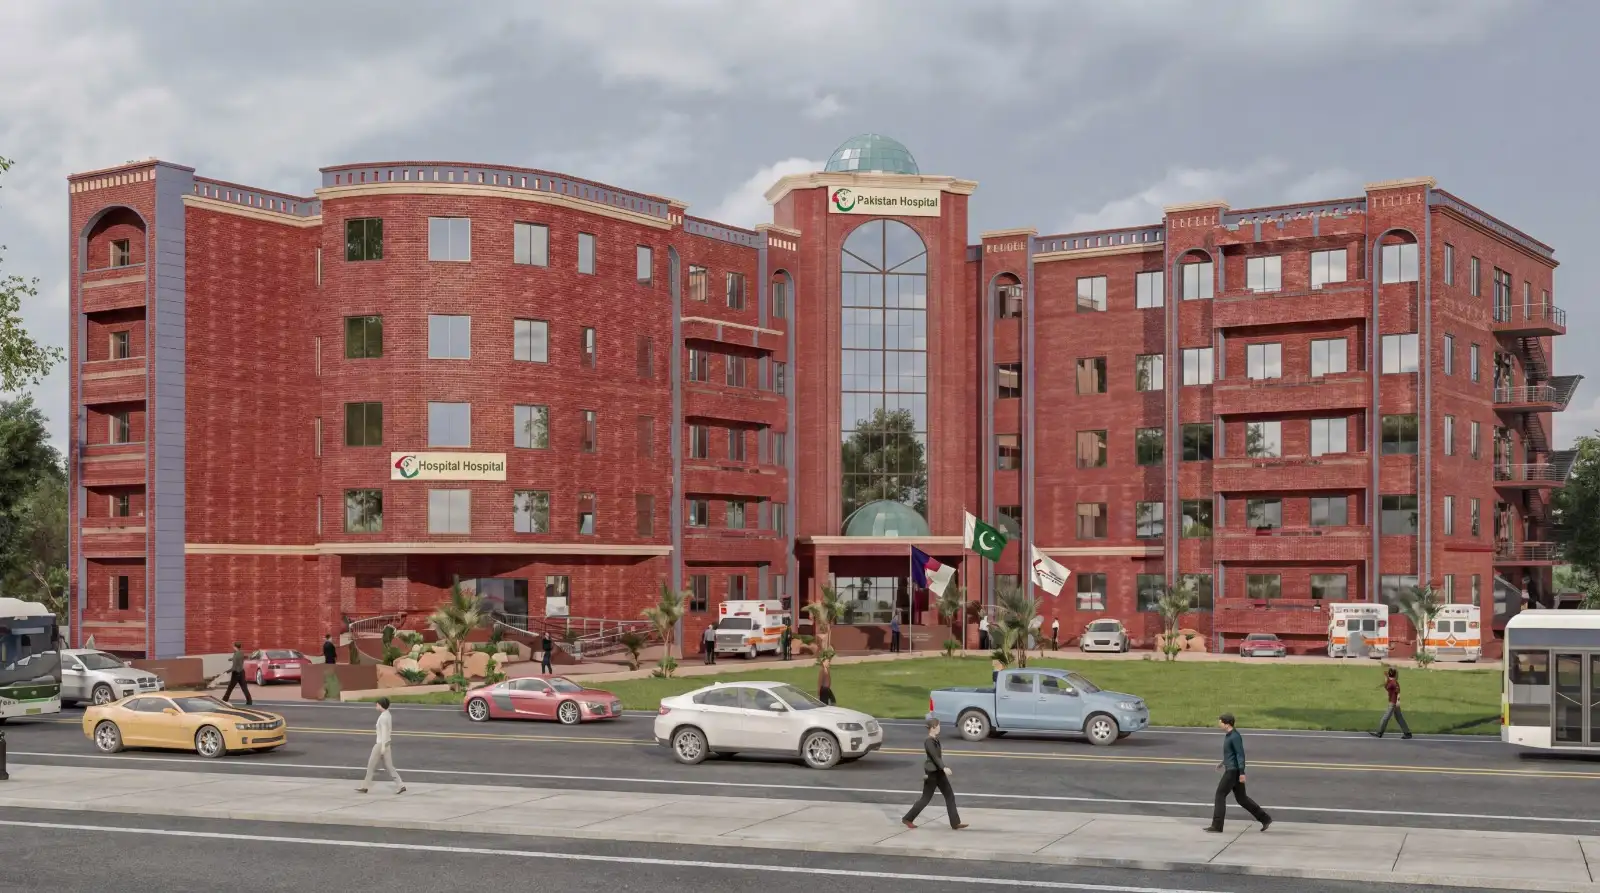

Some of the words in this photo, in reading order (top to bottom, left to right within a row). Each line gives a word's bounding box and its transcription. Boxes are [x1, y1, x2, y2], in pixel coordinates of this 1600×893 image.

[857, 195, 897, 206] Pakistan
[900, 196, 938, 208] Hospital
[419, 460, 460, 473] Hospital
[463, 461, 504, 473] Hospital
